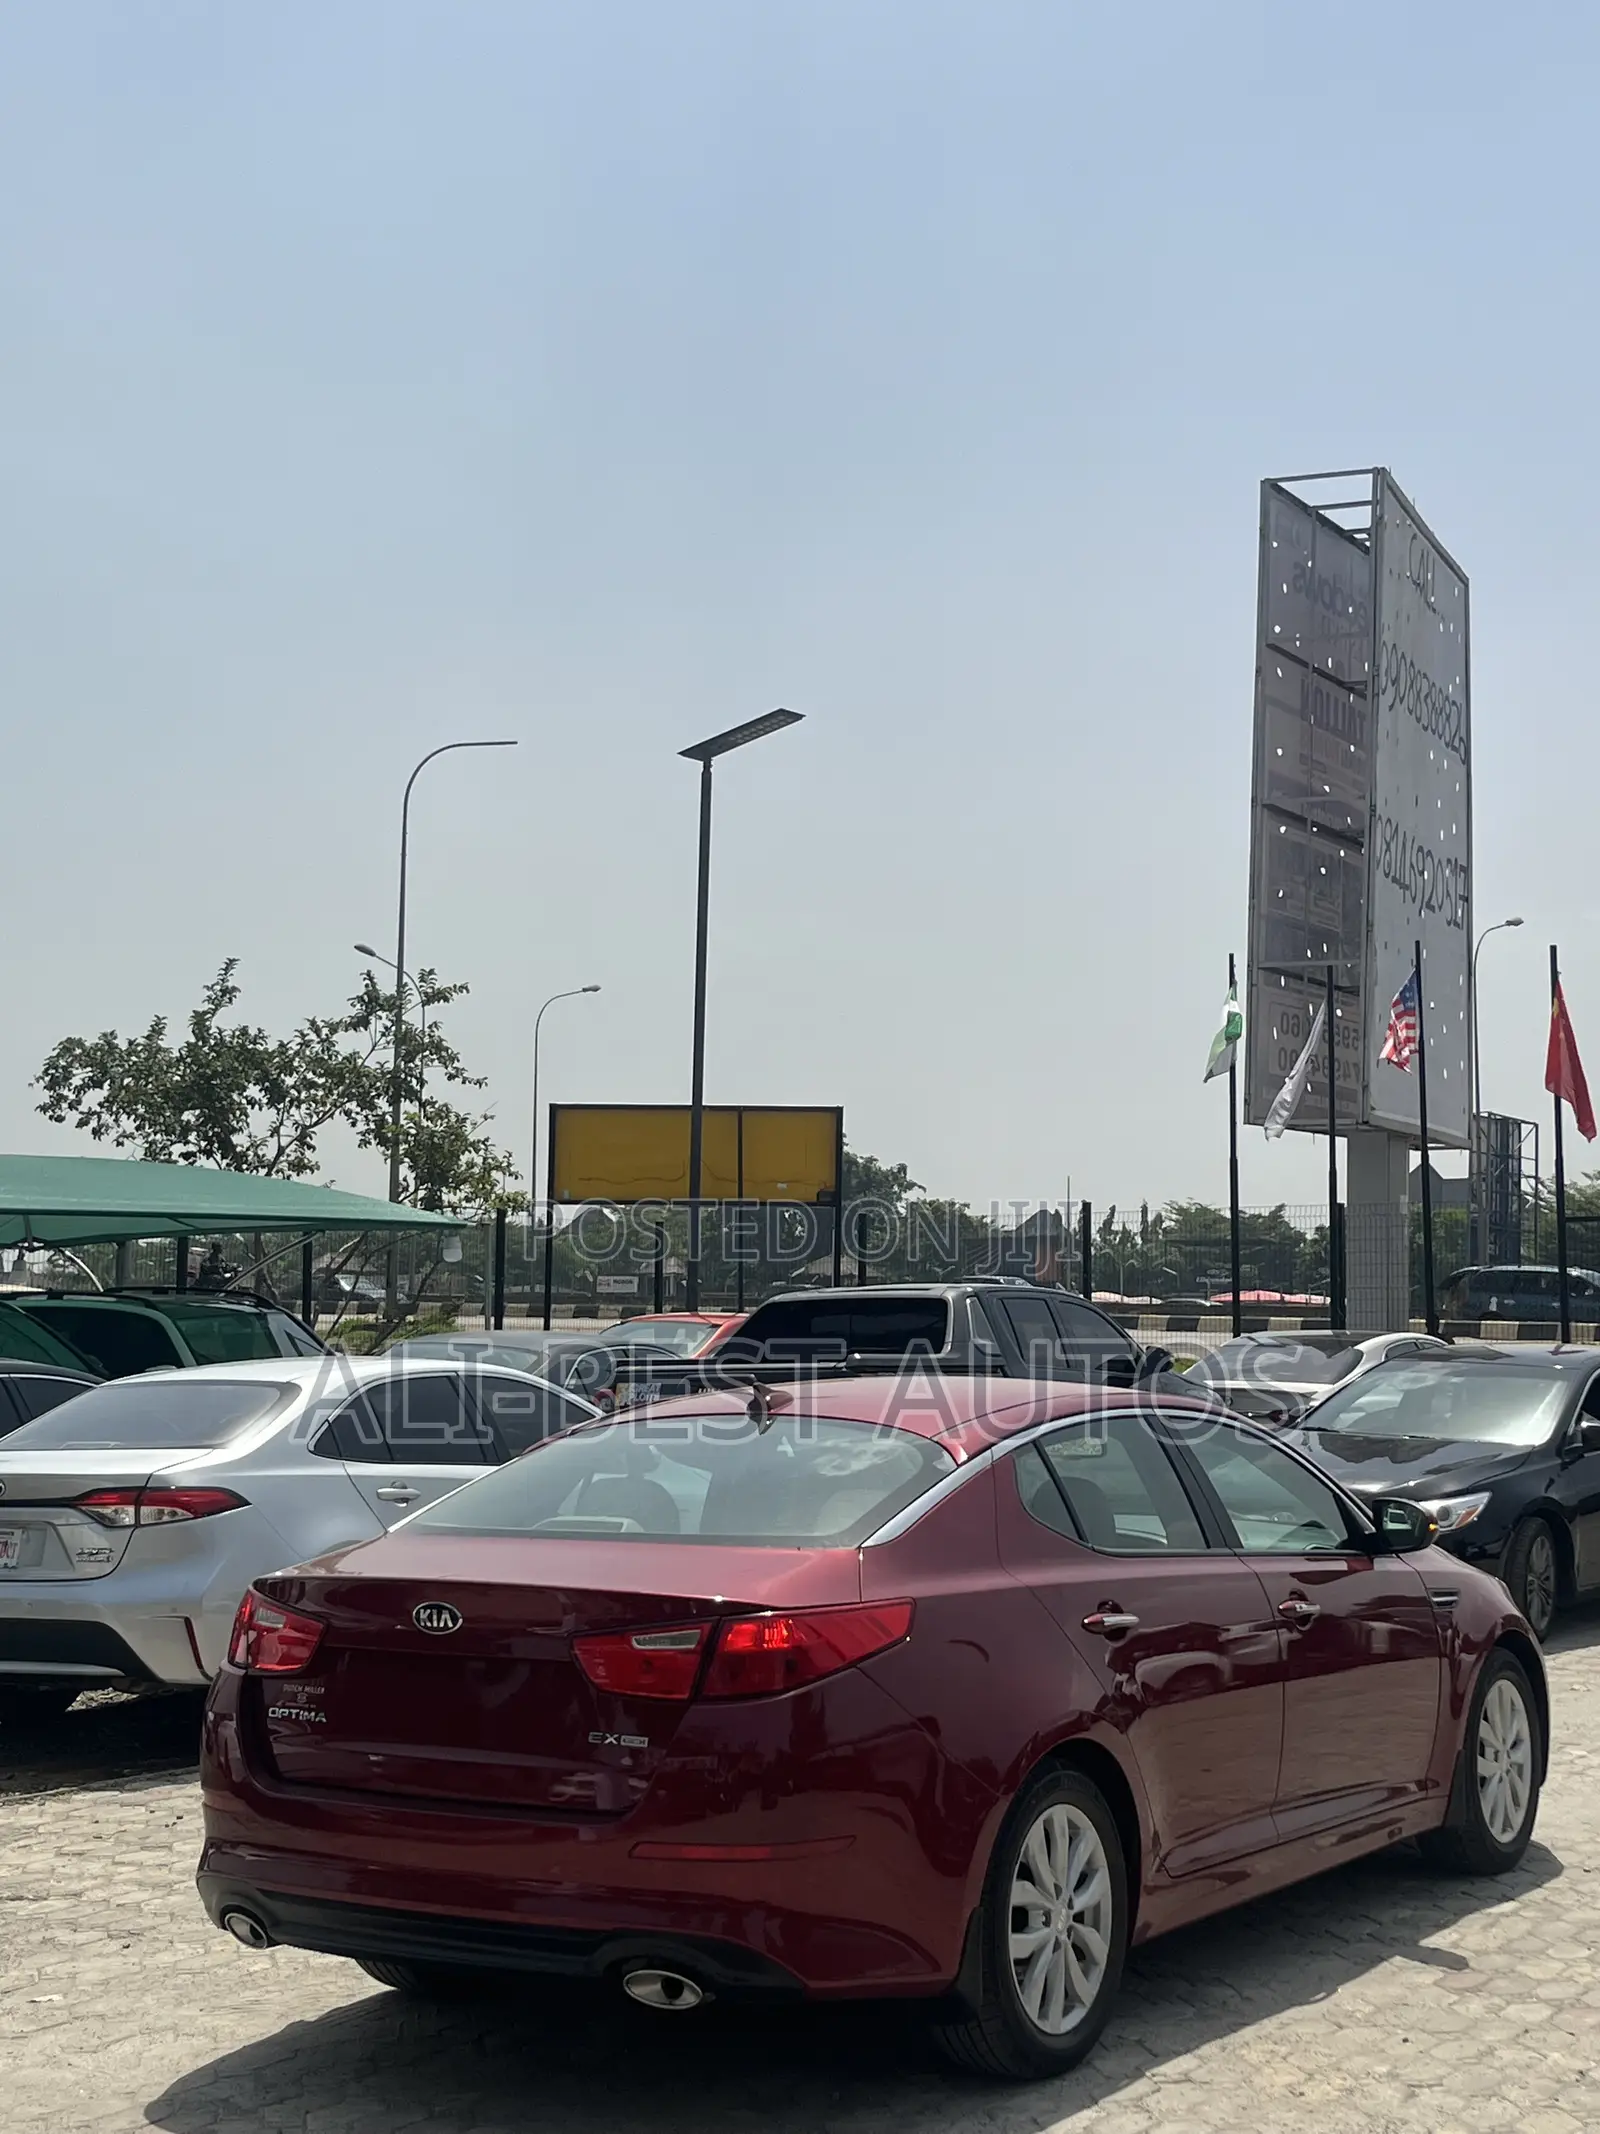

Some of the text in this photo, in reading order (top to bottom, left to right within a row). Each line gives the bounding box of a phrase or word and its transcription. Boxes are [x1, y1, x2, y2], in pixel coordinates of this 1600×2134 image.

[419, 1608, 454, 1628] KIA
[268, 1707, 327, 1723] OPTIMA
[588, 1731, 619, 1744] EX
